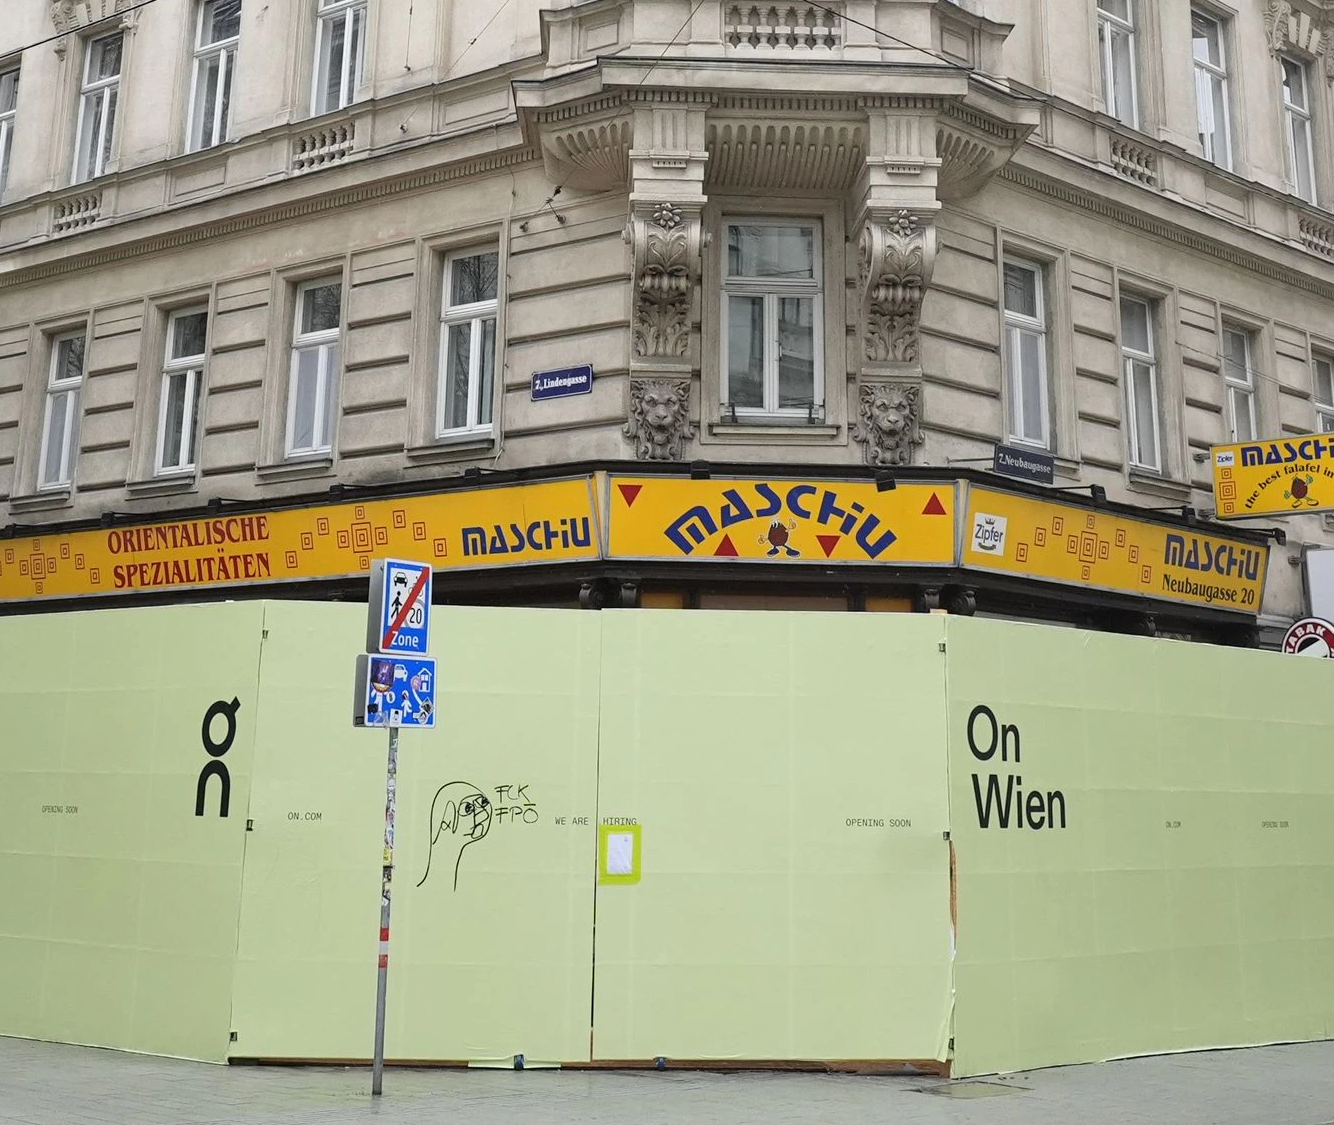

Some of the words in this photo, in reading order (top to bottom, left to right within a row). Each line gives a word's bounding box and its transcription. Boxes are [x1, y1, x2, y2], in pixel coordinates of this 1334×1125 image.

[543, 375, 587, 389] Lindengasse
[1005, 455, 1052, 474] Neubaugasse
[1244, 491, 1260, 509] the
[1259, 470, 1282, 490] best
[1284, 463, 1320, 475] falafel
[1323, 466, 1334, 479] in
[107, 515, 270, 555] ORIENTALISCHE
[975, 523, 1004, 543] Zipfer
[113, 548, 271, 589] SPEZIALITÄTEN
[1162, 573, 1238, 603] Neubaugasse
[1240, 587, 1255, 605] 20
[409, 607, 423, 625] 20
[390, 630, 419, 648] Zone
[1285, 623, 1327, 654] TABAK
[967, 704, 1021, 763] On
[494, 784, 529, 803] FCK
[973, 773, 1067, 829] Wien
[287, 811, 322, 821] ON.COM
[555, 817, 569, 826] WE
[571, 817, 589, 826] ARE
[603, 817, 637, 826] HIRING
[845, 818, 885, 827] OPENING
[889, 818, 912, 828] SOON
